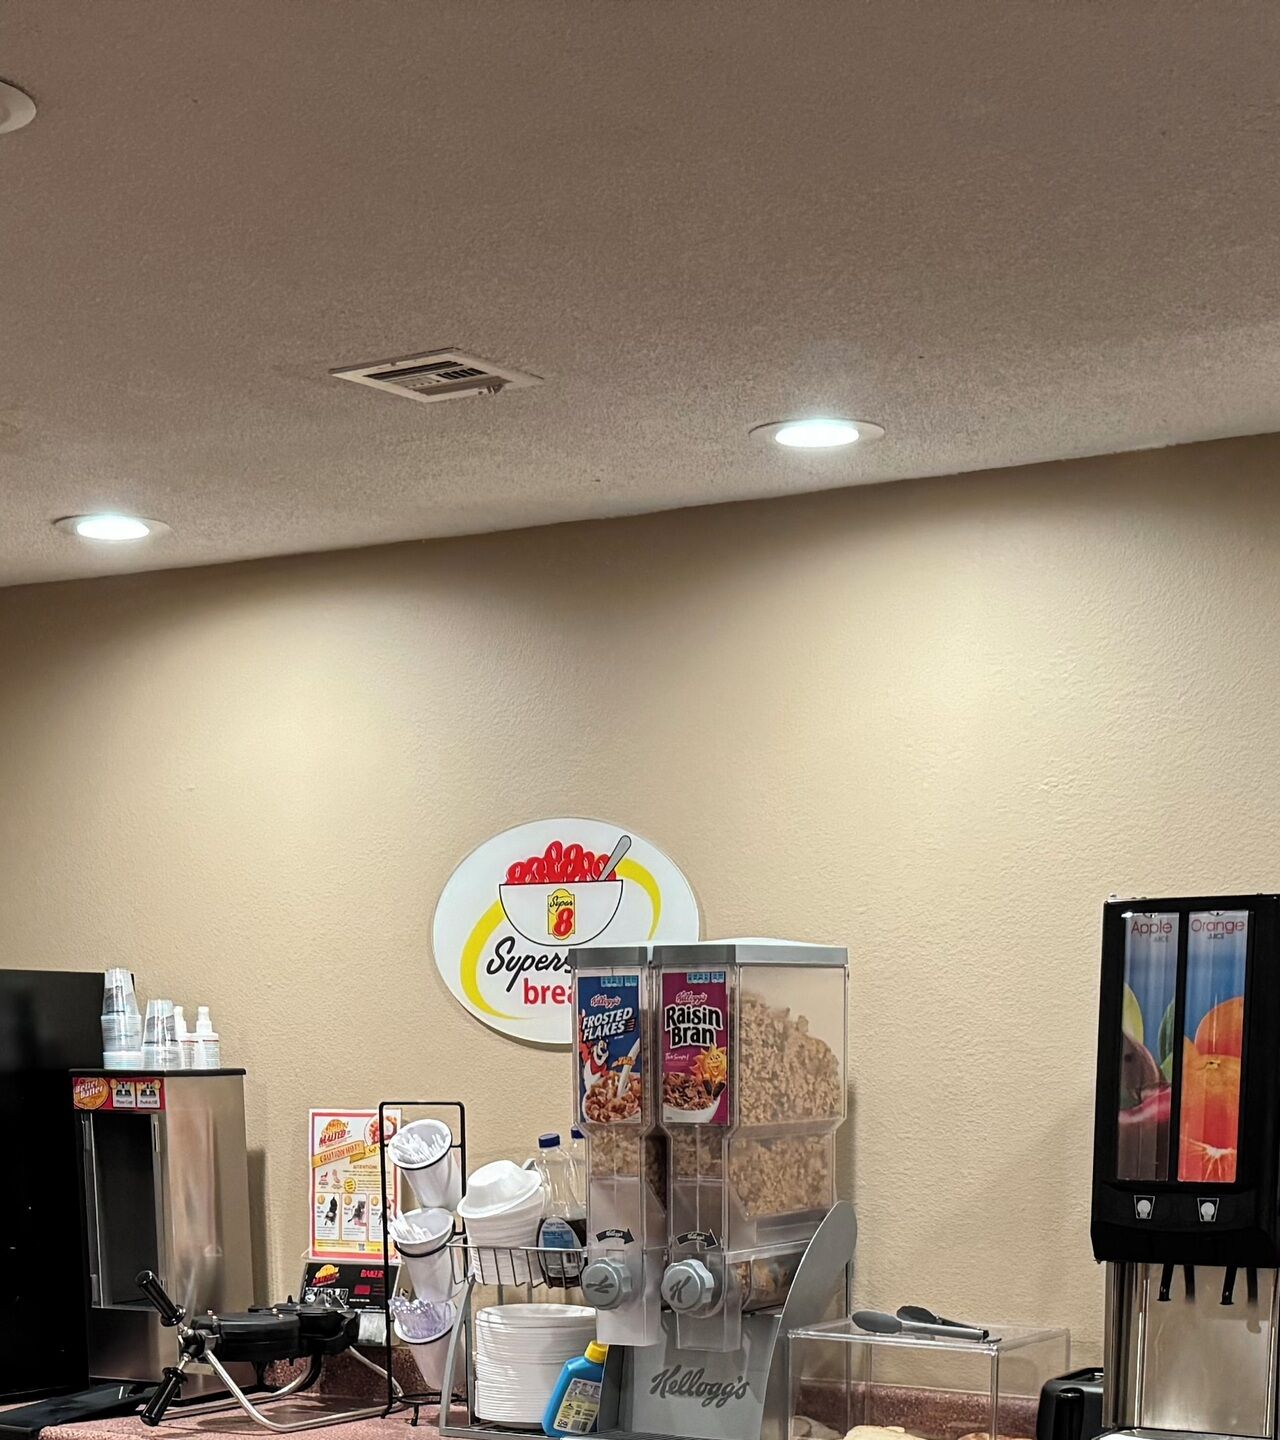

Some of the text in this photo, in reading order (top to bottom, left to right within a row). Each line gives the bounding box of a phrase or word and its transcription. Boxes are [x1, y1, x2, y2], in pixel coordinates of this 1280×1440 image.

[549, 896, 573, 912] Super
[553, 907, 574, 938] 8
[1130, 920, 1172, 936] Apple
[1191, 919, 1245, 934] Orange
[582, 1007, 632, 1030] FROSTED
[665, 1004, 723, 1031] Raisin
[583, 1020, 625, 1041] FLAKES
[671, 1026, 716, 1048] Bran
[650, 1364, 750, 1408] Kellogg's
